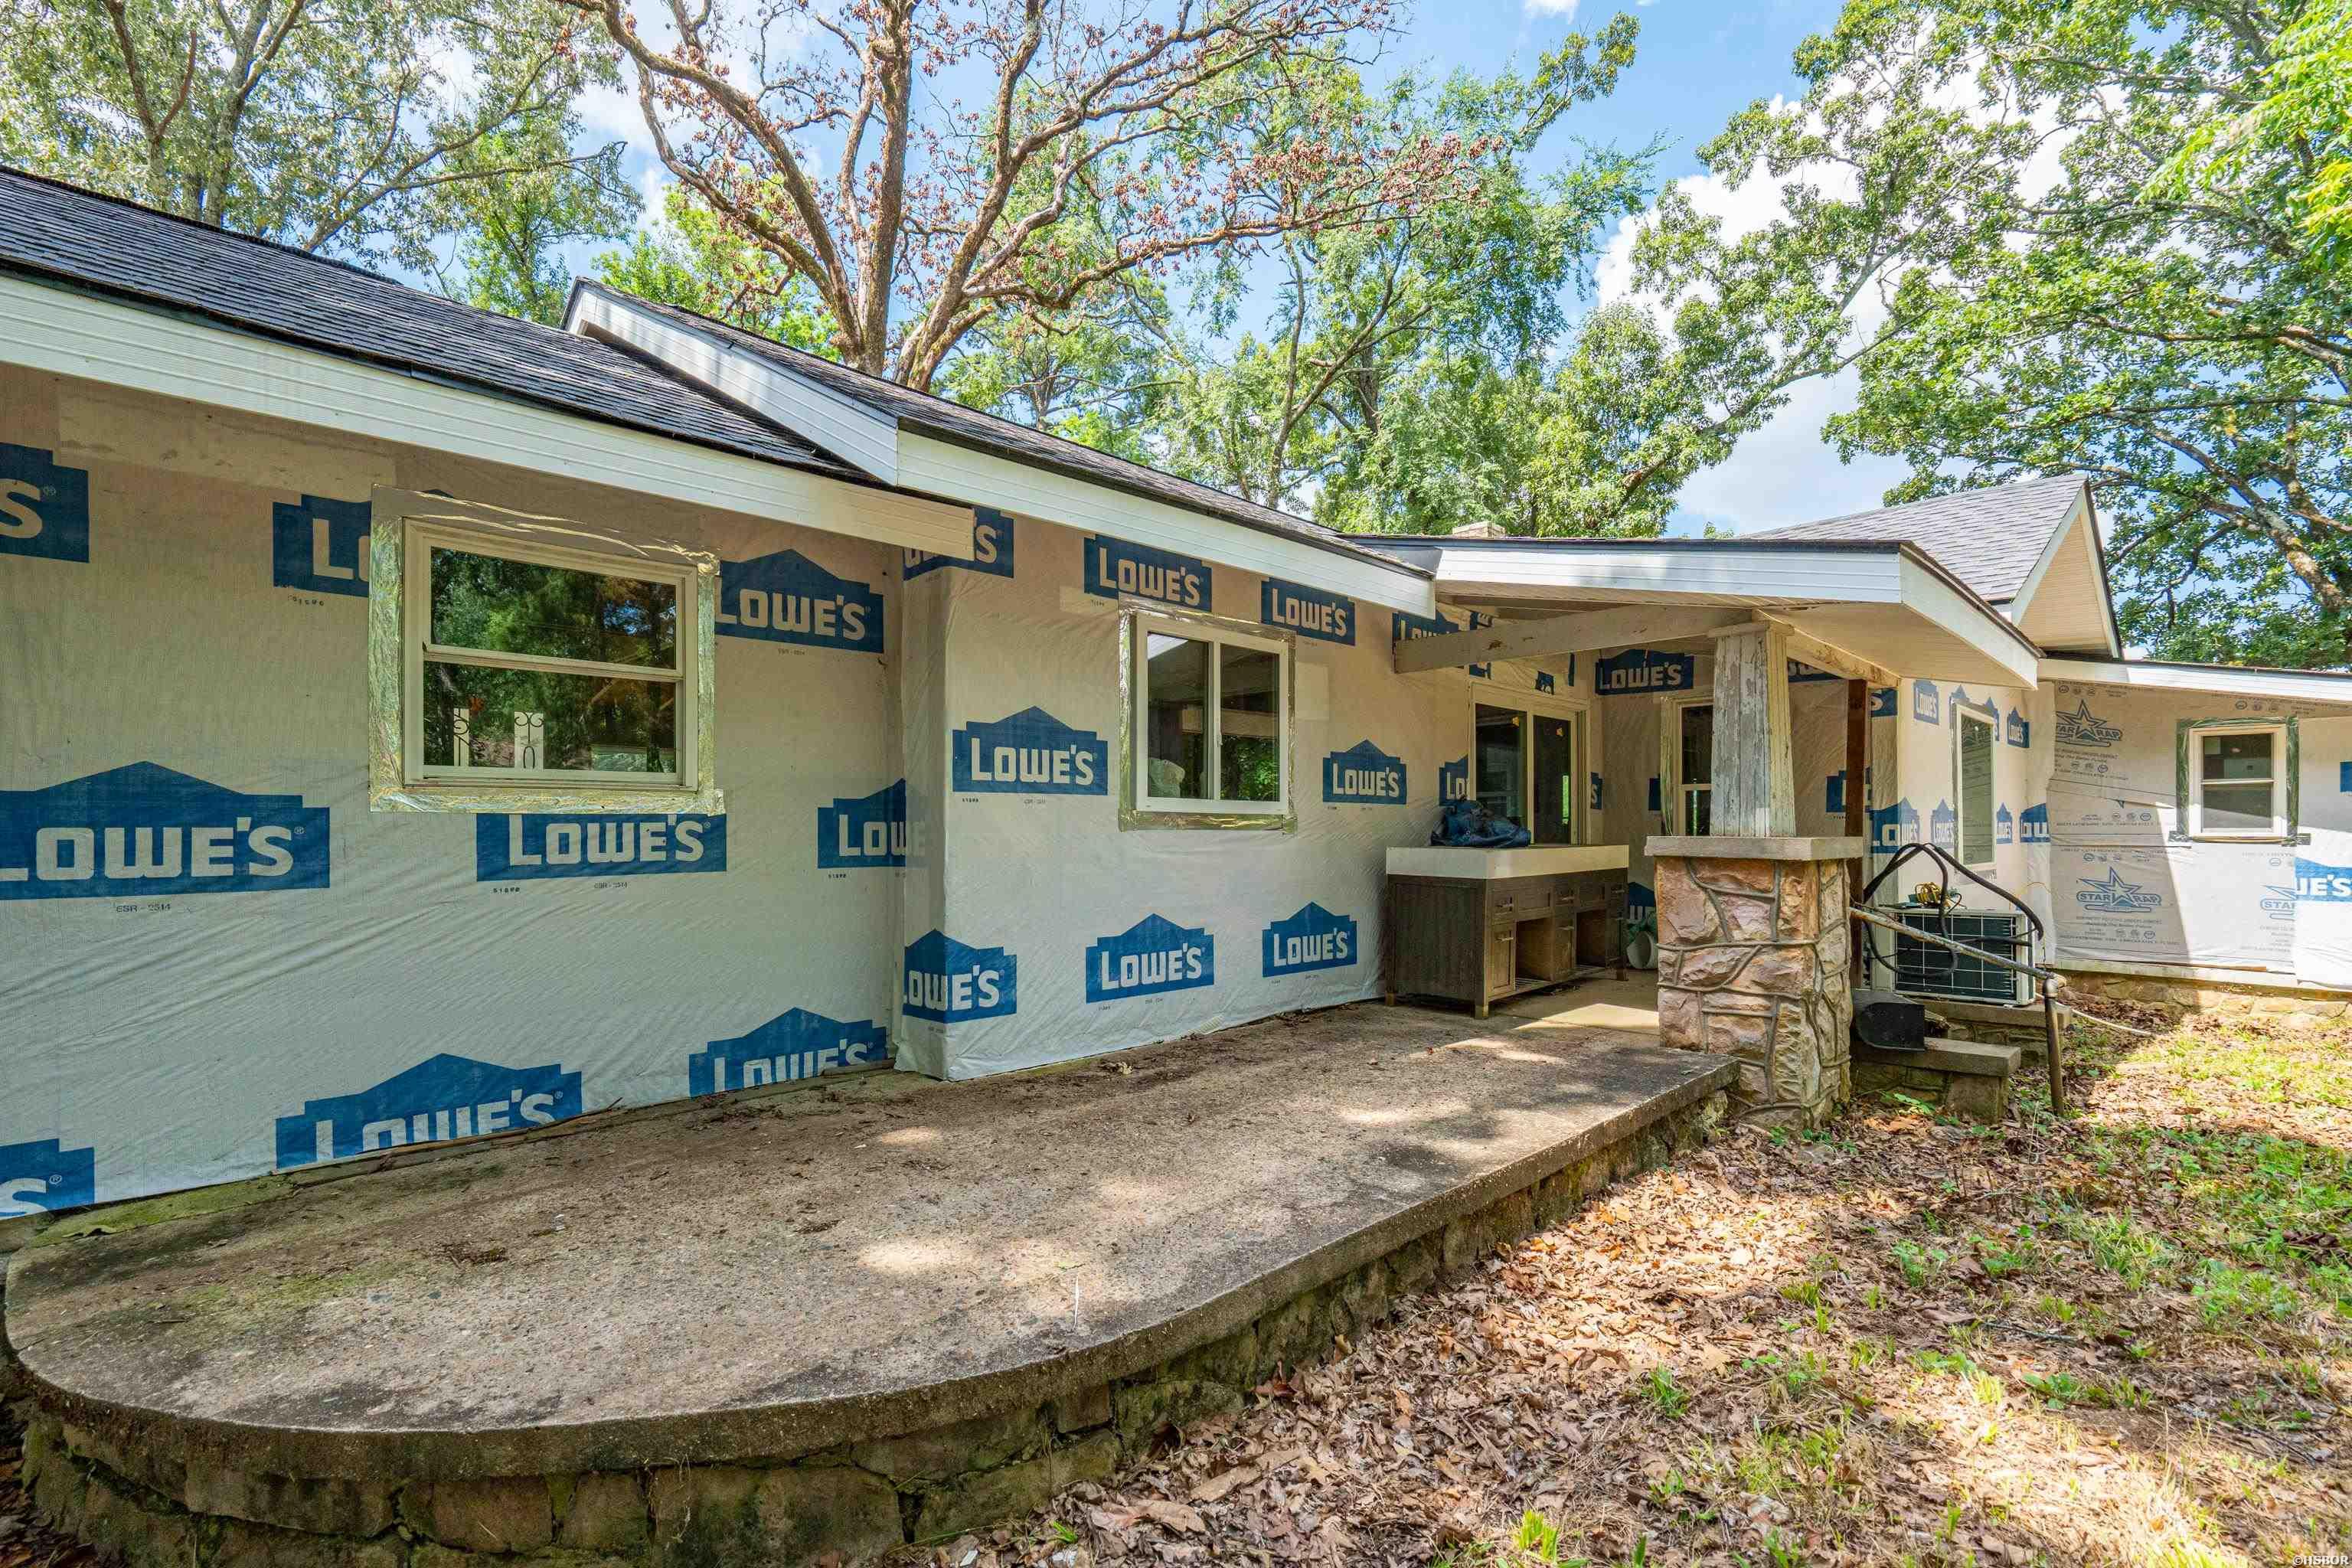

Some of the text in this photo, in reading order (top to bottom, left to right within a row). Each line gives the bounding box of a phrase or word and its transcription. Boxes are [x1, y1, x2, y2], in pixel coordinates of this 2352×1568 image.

[1099, 547, 1200, 606] LOWE'S
[1272, 588, 1347, 637] LOWE'S
[971, 737, 1094, 786] LOWE'S
[1332, 763, 1400, 798] LOWE'S
[509, 814, 705, 866] LOWE'S
[1101, 942, 1202, 990] LOWE'S
[1273, 927, 1348, 967] LOWE'S
[903, 965, 1000, 1011] OWE'S
